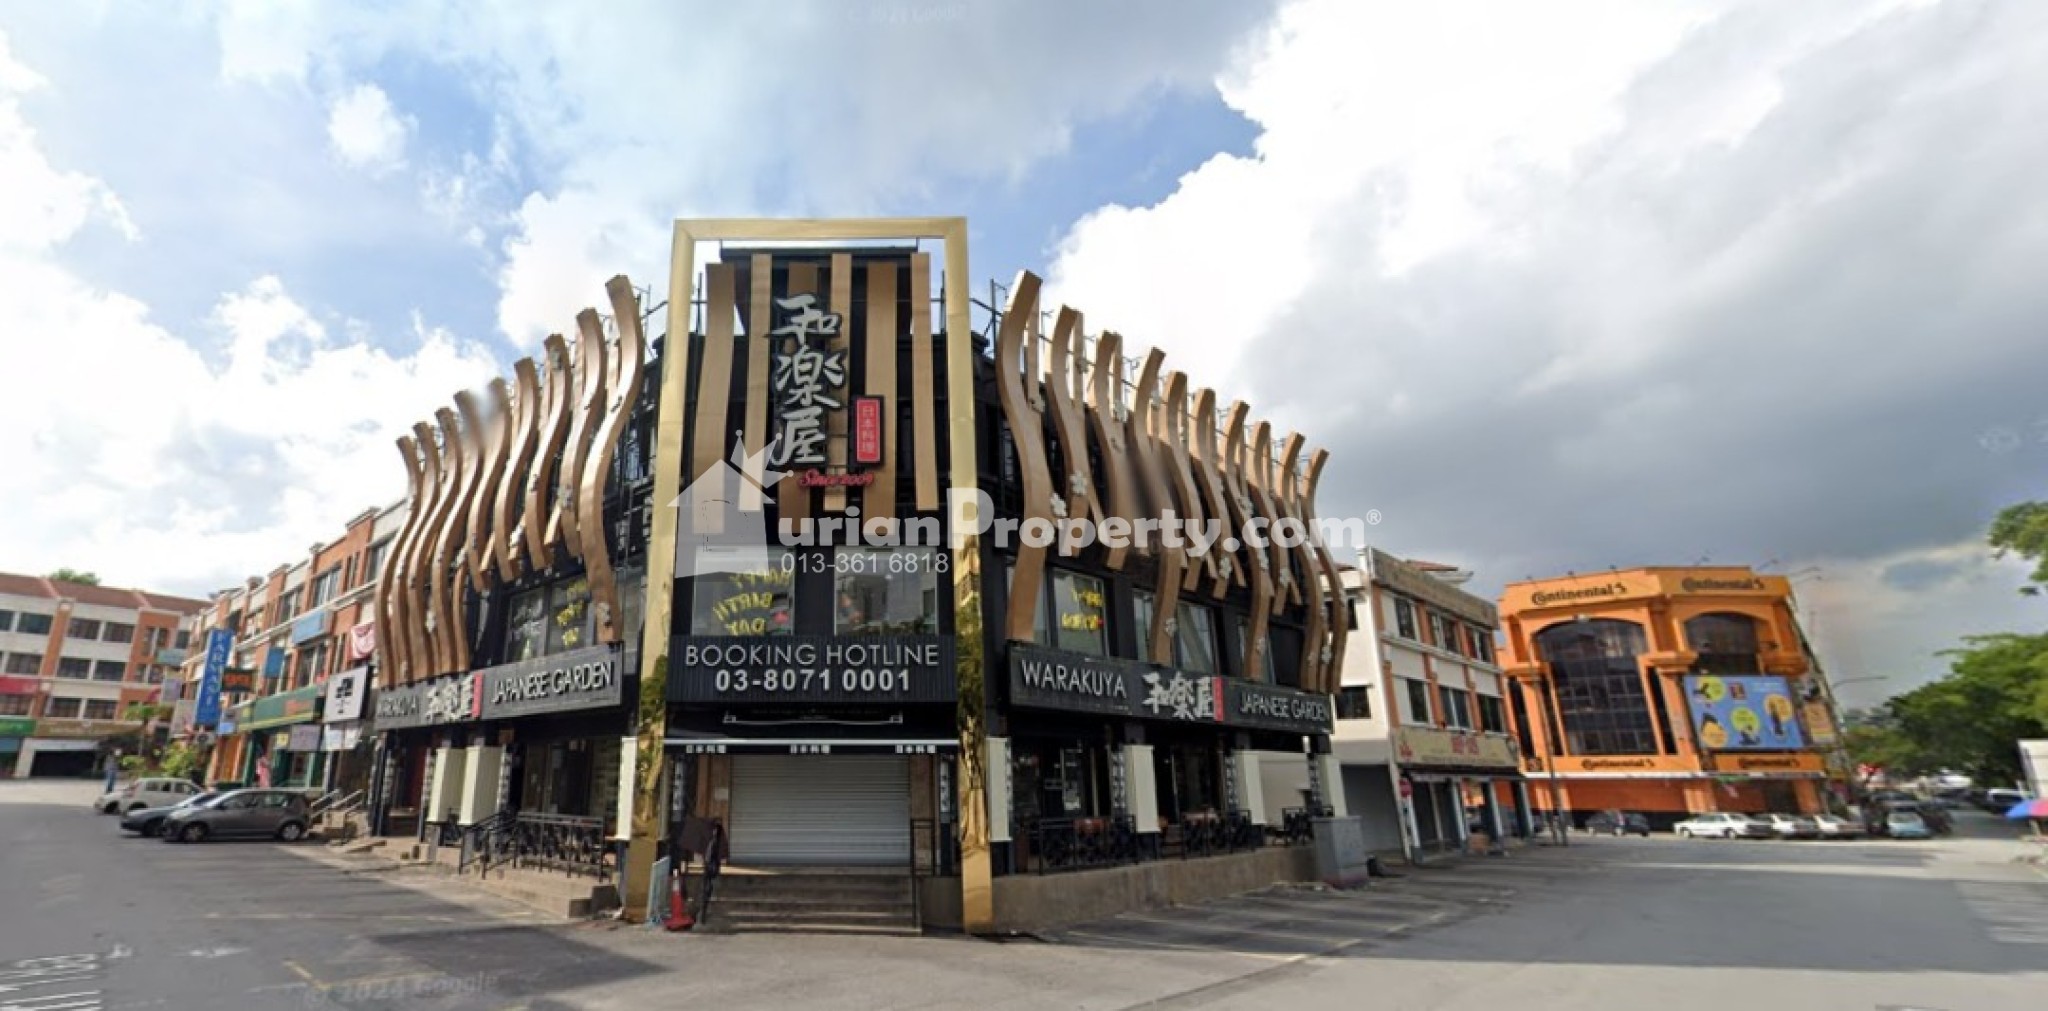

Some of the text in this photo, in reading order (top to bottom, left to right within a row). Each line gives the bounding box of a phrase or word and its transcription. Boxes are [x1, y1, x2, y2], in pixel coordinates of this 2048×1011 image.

[800, 468, 838, 487] Since
[1532, 584, 1613, 605] Continental
[685, 644, 940, 667] BOOKING HOTLINE
[491, 670, 551, 704] JAPANESE
[552, 661, 613, 695] GARDEN
[715, 668, 911, 692] 03-8071 0001
[1021, 658, 1127, 699] WARAKUYA
[1239, 691, 1290, 719] JAPANESE
